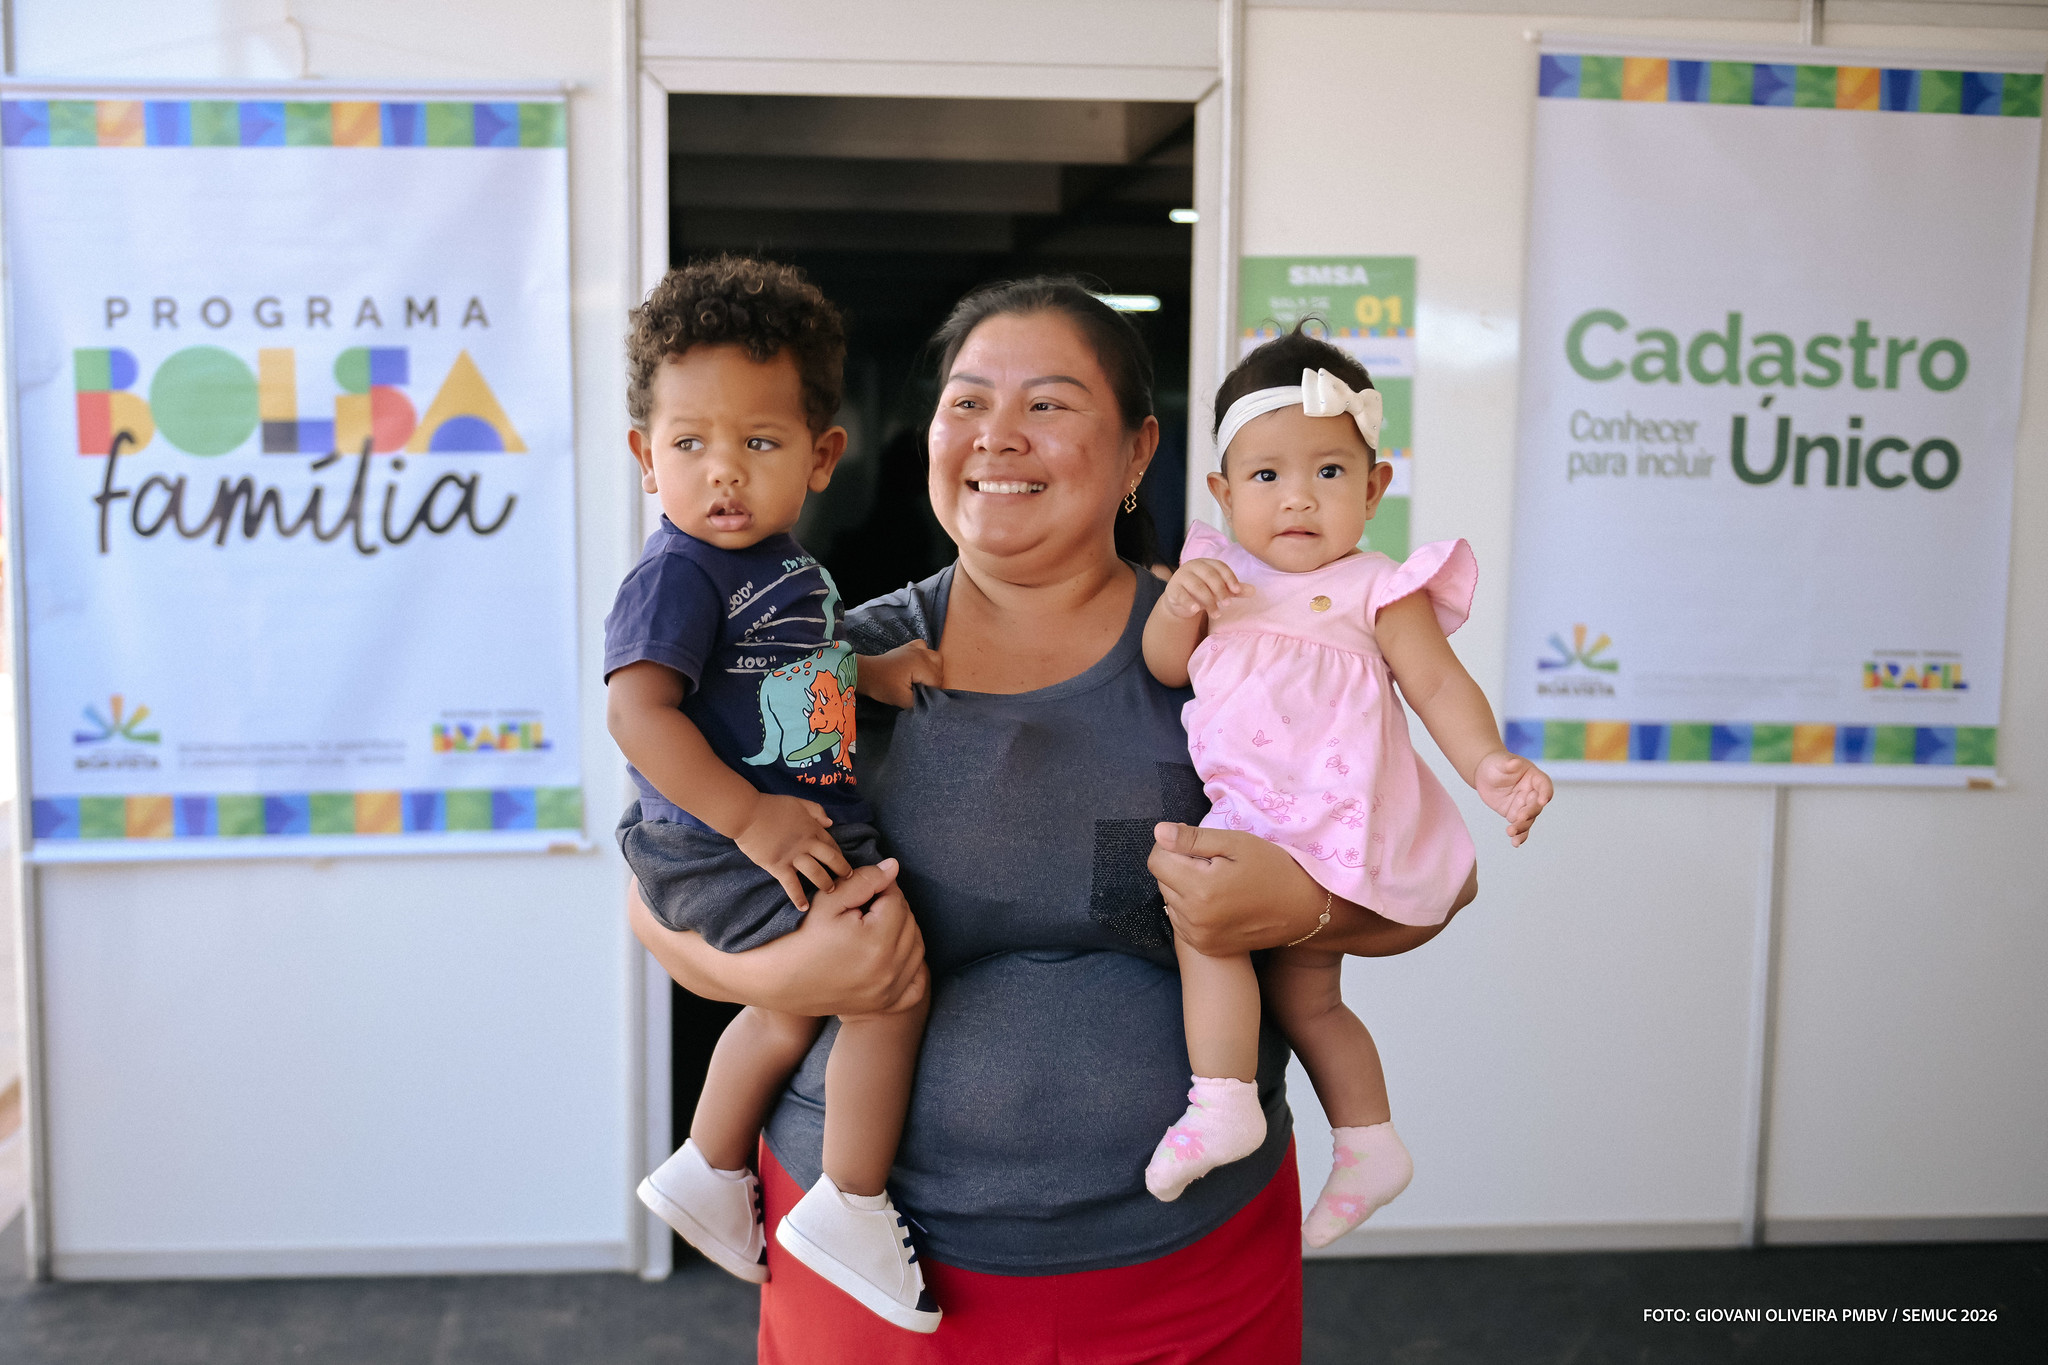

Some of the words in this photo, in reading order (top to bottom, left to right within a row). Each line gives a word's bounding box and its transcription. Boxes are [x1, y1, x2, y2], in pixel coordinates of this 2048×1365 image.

[1289, 265, 1369, 286] SMSA
[105, 296, 490, 329] PROGRAMA
[1355, 295, 1403, 325] 01
[1565, 308, 1969, 392] Cadastro
[74, 344, 529, 457] BOLSA
[1570, 409, 1699, 443] Conhecer
[1730, 395, 1962, 490] Único
[1567, 450, 1628, 482] para
[1637, 447, 1716, 479] incluir
[92, 429, 518, 555] família
[1862, 661, 1969, 690] BRASIL
[431, 722, 553, 753] BRASIL
